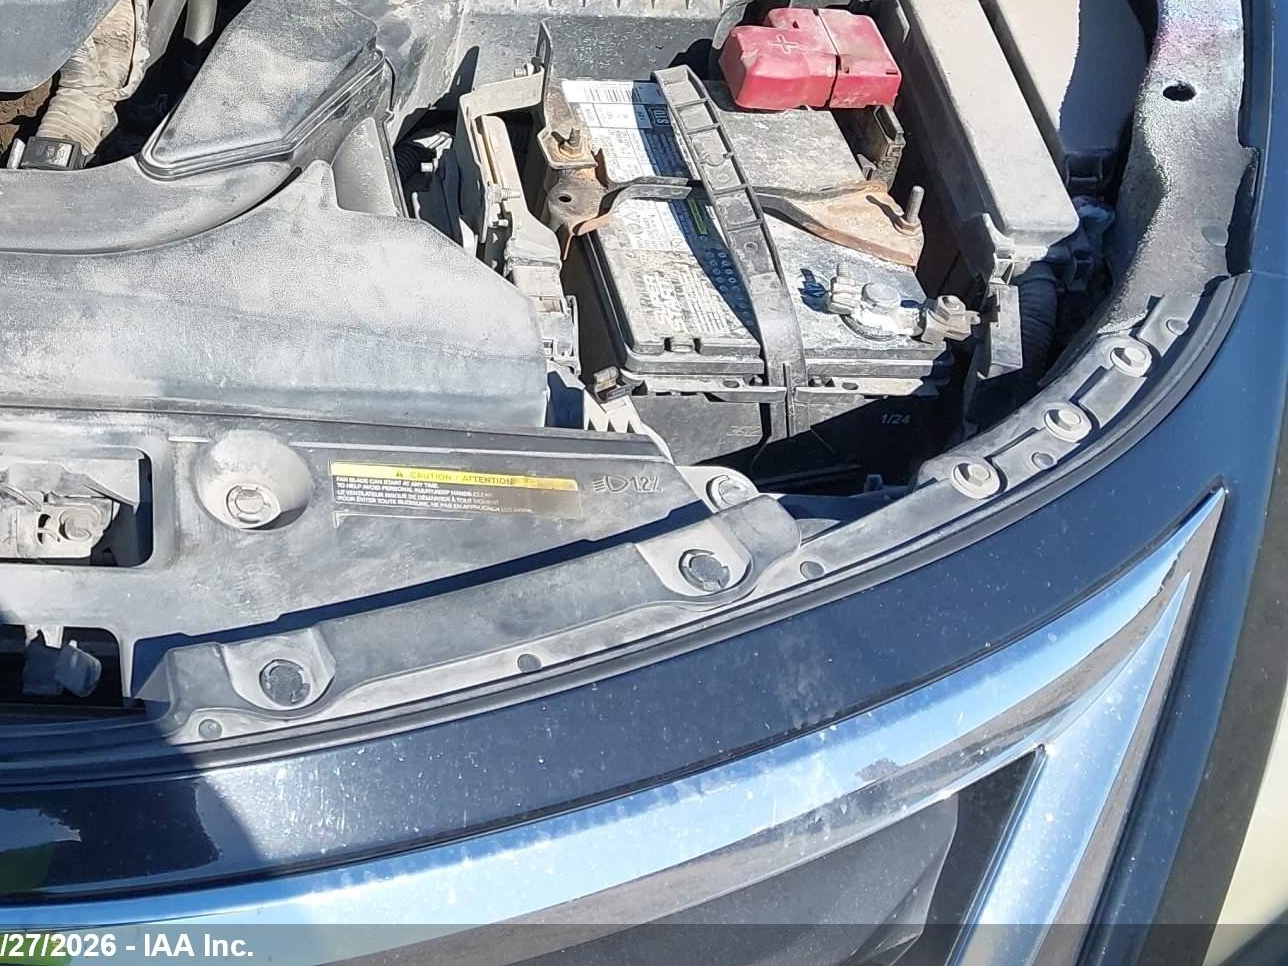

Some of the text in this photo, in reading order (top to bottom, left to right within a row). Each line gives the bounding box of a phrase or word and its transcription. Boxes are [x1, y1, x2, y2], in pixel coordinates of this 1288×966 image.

[880, 413, 911, 425] 1/24
[410, 472, 451, 482] CAUTION
[462, 475, 513, 485] ATTENTION
